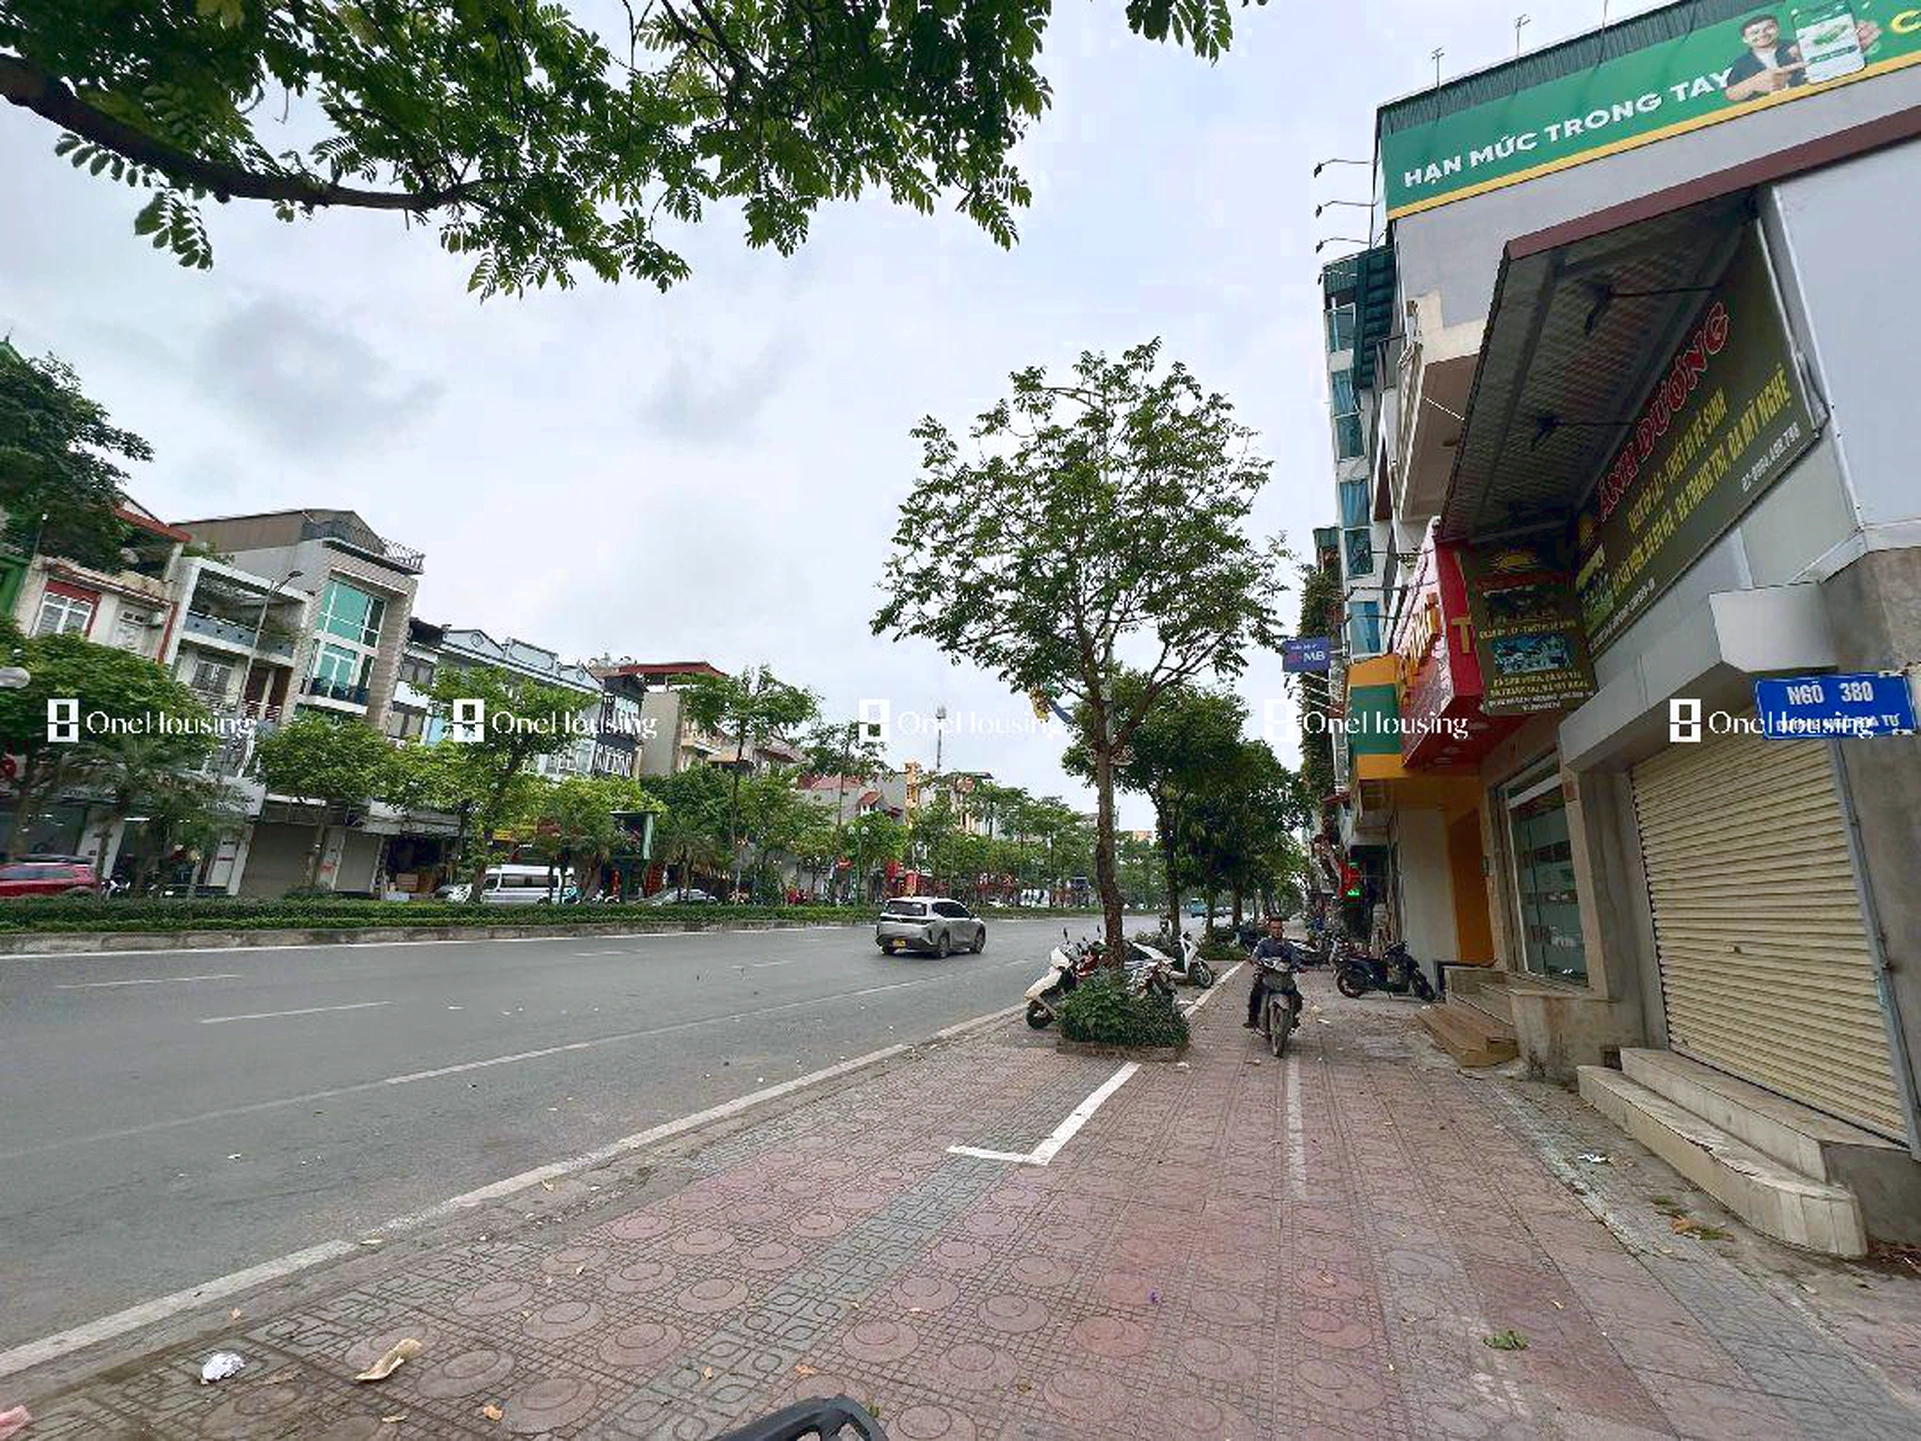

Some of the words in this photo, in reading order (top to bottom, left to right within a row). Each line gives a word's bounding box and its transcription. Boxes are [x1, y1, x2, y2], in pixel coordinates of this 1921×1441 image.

[1404, 155, 1461, 187] HẠN
[1470, 132, 1538, 168] MỨC
[1544, 93, 1662, 143] TRONG
[1669, 67, 1733, 103] TAY
[1838, 680, 1875, 703] 380
